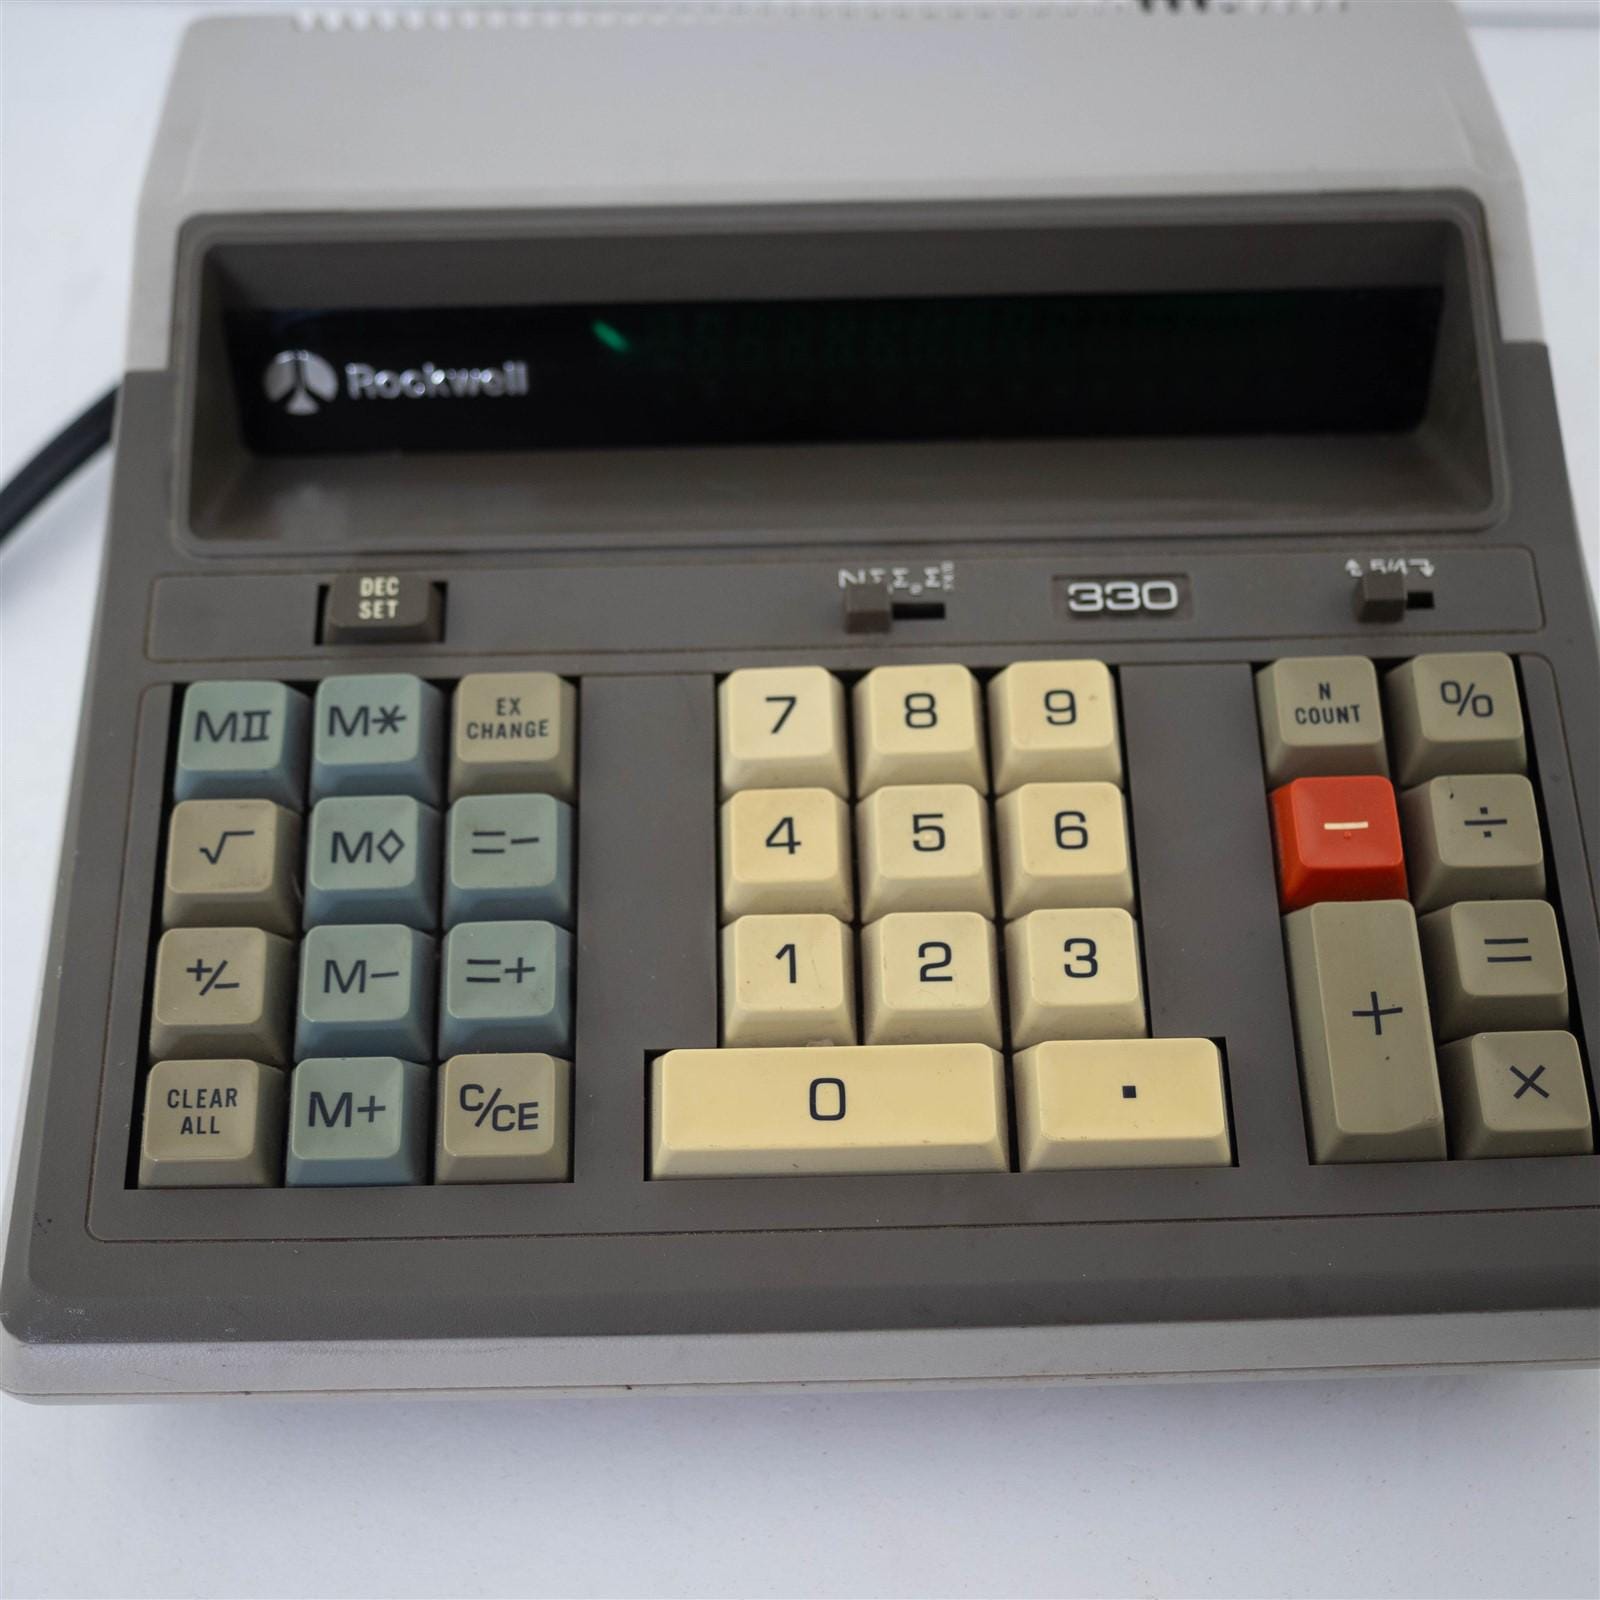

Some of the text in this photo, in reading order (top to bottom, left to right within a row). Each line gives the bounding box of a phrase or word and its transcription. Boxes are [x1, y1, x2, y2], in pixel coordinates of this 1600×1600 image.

[346, 361, 529, 399] Rockwell
[361, 578, 398, 596] DEC
[1068, 581, 1178, 611] 330
[360, 600, 397, 619] SET
[496, 697, 520, 716] EX
[1044, 690, 1076, 725] 9
[1319, 683, 1331, 700] N
[1440, 681, 1493, 717] %
[766, 696, 796, 734] 7
[904, 693, 937, 729] 8
[1295, 704, 1359, 724] COUNT
[467, 720, 547, 739] CHANGE
[766, 817, 801, 854] 4
[913, 813, 945, 852] 5
[1055, 811, 1088, 850] 6
[776, 944, 796, 983] 1
[918, 942, 953, 982] 2
[1064, 938, 1098, 978] 3
[167, 1088, 237, 1108] CLEAR
[308, 1091, 385, 1127] M+
[460, 1084, 538, 1131] C/CE
[809, 1078, 846, 1121] 0
[181, 1116, 220, 1134] ALL
